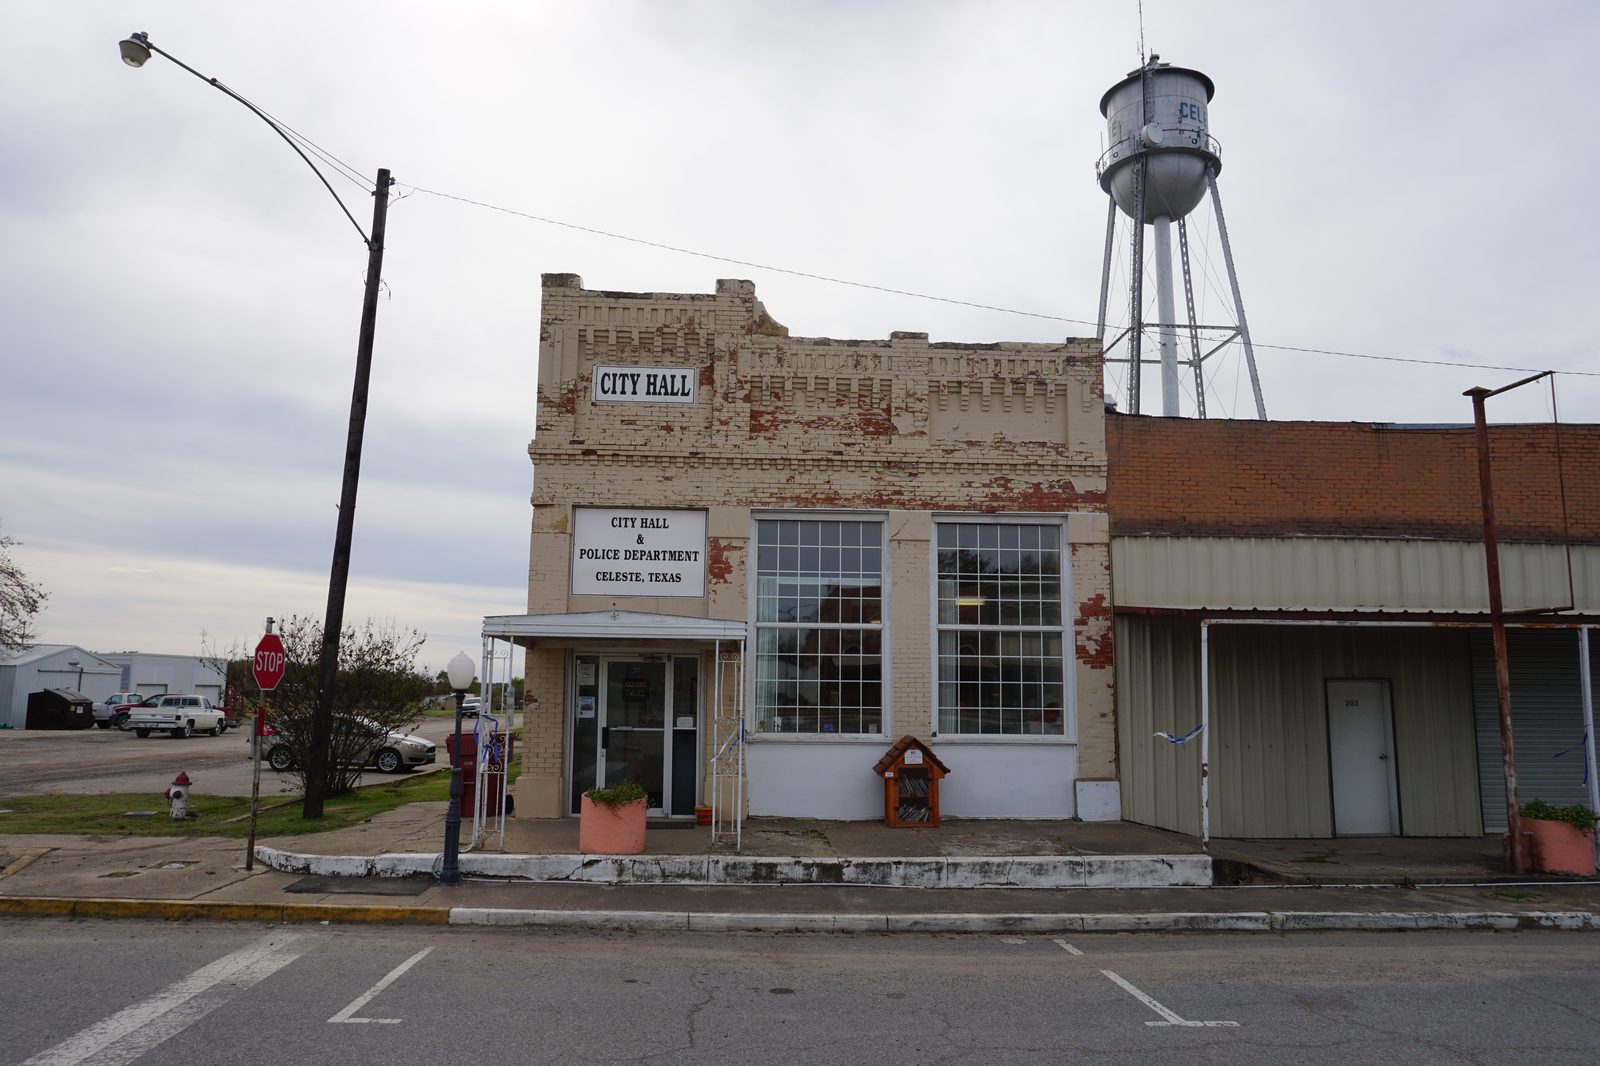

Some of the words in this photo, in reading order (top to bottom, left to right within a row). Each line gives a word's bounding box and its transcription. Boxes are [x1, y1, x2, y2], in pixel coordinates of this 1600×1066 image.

[601, 372, 641, 395] CITY
[645, 373, 691, 397] HALL
[611, 517, 637, 528] CITY
[640, 518, 669, 529] HALL
[636, 533, 645, 545] &
[579, 548, 620, 560] POLICE
[624, 549, 700, 562] DEPARTMENT
[595, 571, 645, 583] CELESTE,
[648, 572, 682, 583] TEXAS
[256, 651, 283, 672] STOP
